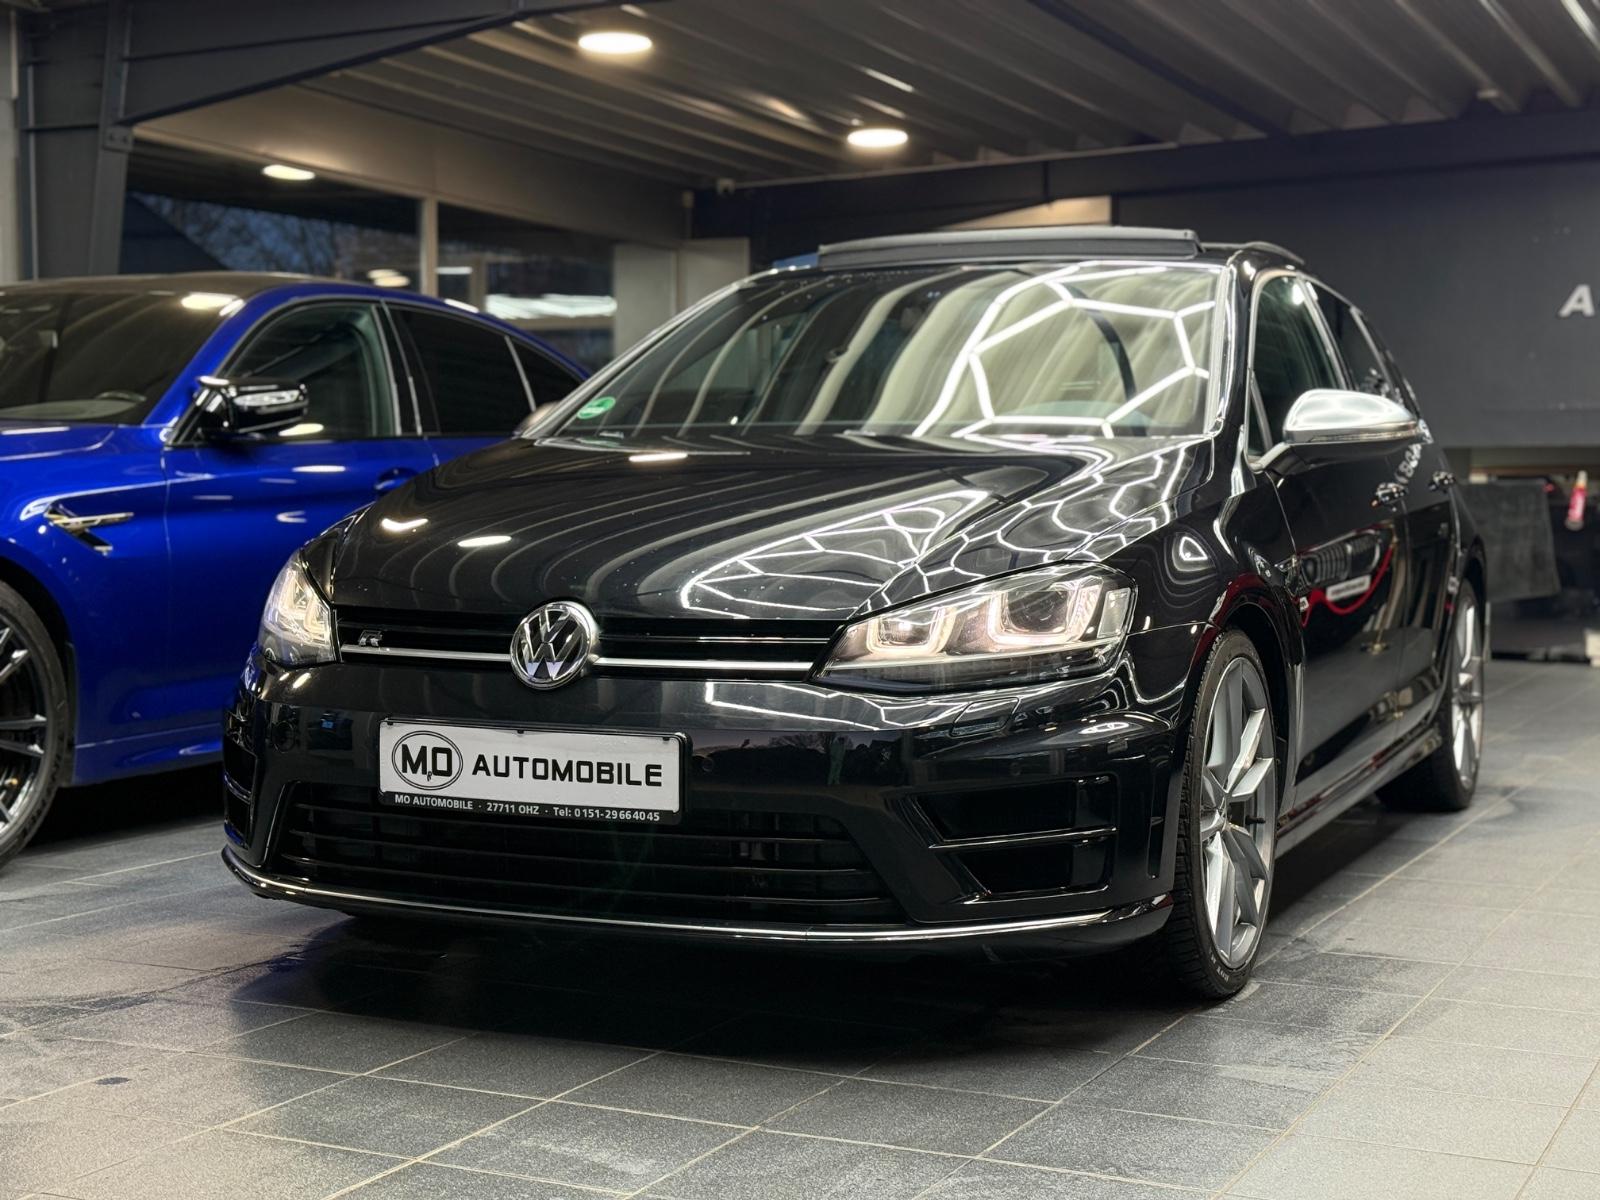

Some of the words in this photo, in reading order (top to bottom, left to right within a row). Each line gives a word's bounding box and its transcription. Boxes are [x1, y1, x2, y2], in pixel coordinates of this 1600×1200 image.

[1559, 283, 1594, 316] A
[472, 753, 662, 787] AUTOMOBILE
[395, 794, 410, 804] MO
[413, 796, 473, 810] AUTOMOBILE
[487, 802, 515, 813] 27711
[519, 804, 539, 815] OHZ
[553, 807, 571, 817] Tel:
[574, 808, 660, 822] 0151-29664045
